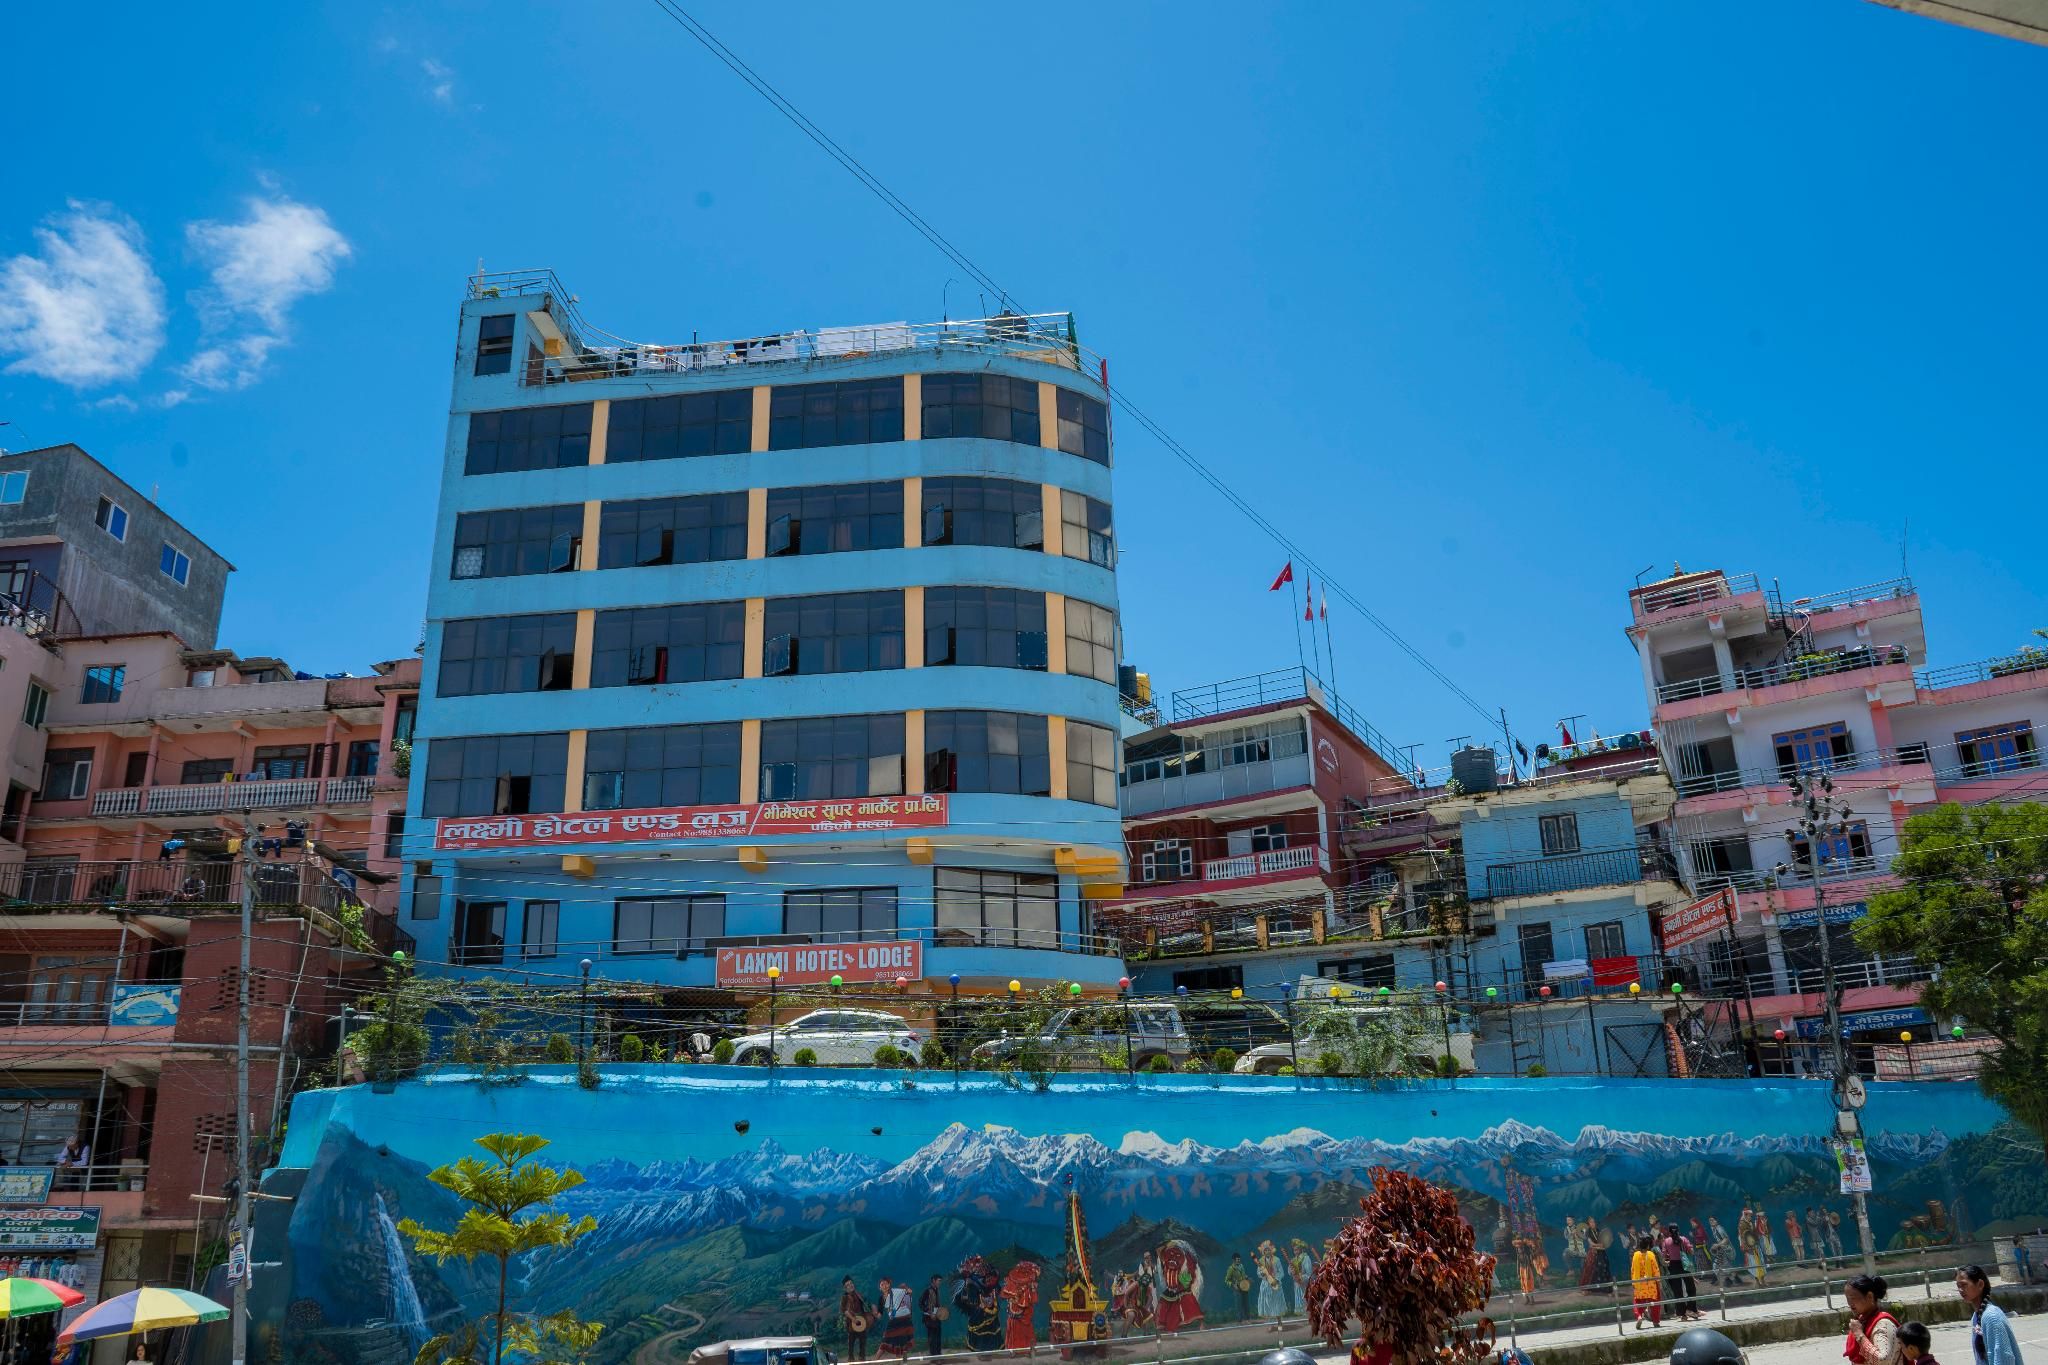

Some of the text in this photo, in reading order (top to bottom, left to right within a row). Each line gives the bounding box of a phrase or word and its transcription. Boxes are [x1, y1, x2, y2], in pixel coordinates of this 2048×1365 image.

[764, 803, 818, 820] भीमेश्वर
[822, 804, 854, 820] सुपर
[858, 798, 900, 815] मार्केट
[444, 810, 750, 841] लक्ष्मी होटल एण्ड लज
[649, 830, 681, 838] Contact
[735, 951, 788, 974] LAXMI
[795, 950, 847, 972] HOTEL
[858, 946, 913, 969] LODGE
